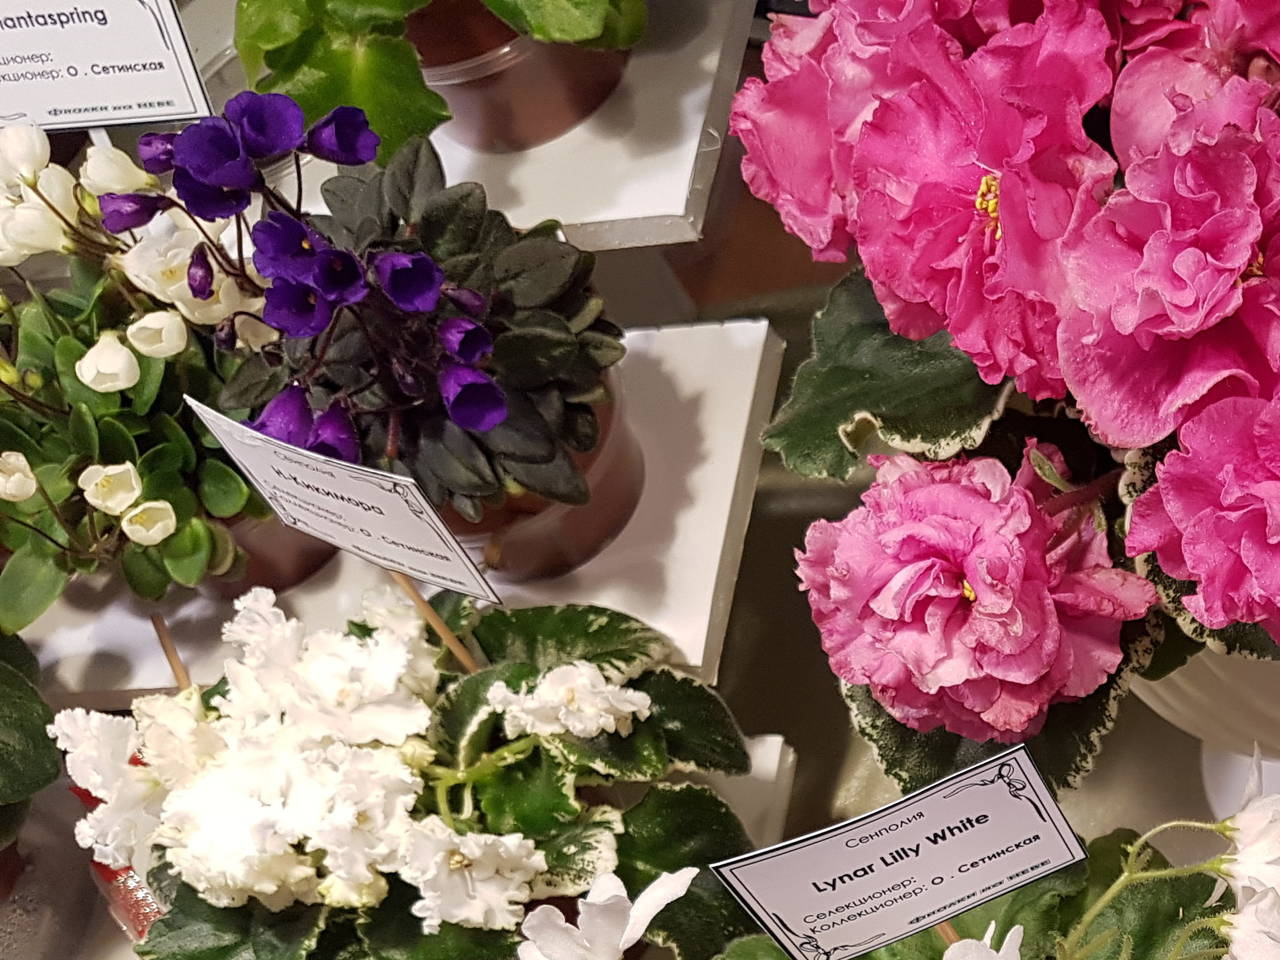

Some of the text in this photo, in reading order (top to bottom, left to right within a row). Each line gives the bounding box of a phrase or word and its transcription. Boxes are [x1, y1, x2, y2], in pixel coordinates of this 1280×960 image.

[90, 61, 165, 75] Сетинская
[811, 813, 990, 894] Lynar Lilly White
[844, 811, 925, 849] Сенполия
[803, 876, 917, 925] Селекционер:
[809, 884, 929, 935] Коллекционер:
[957, 833, 1042, 873] Сетинская
